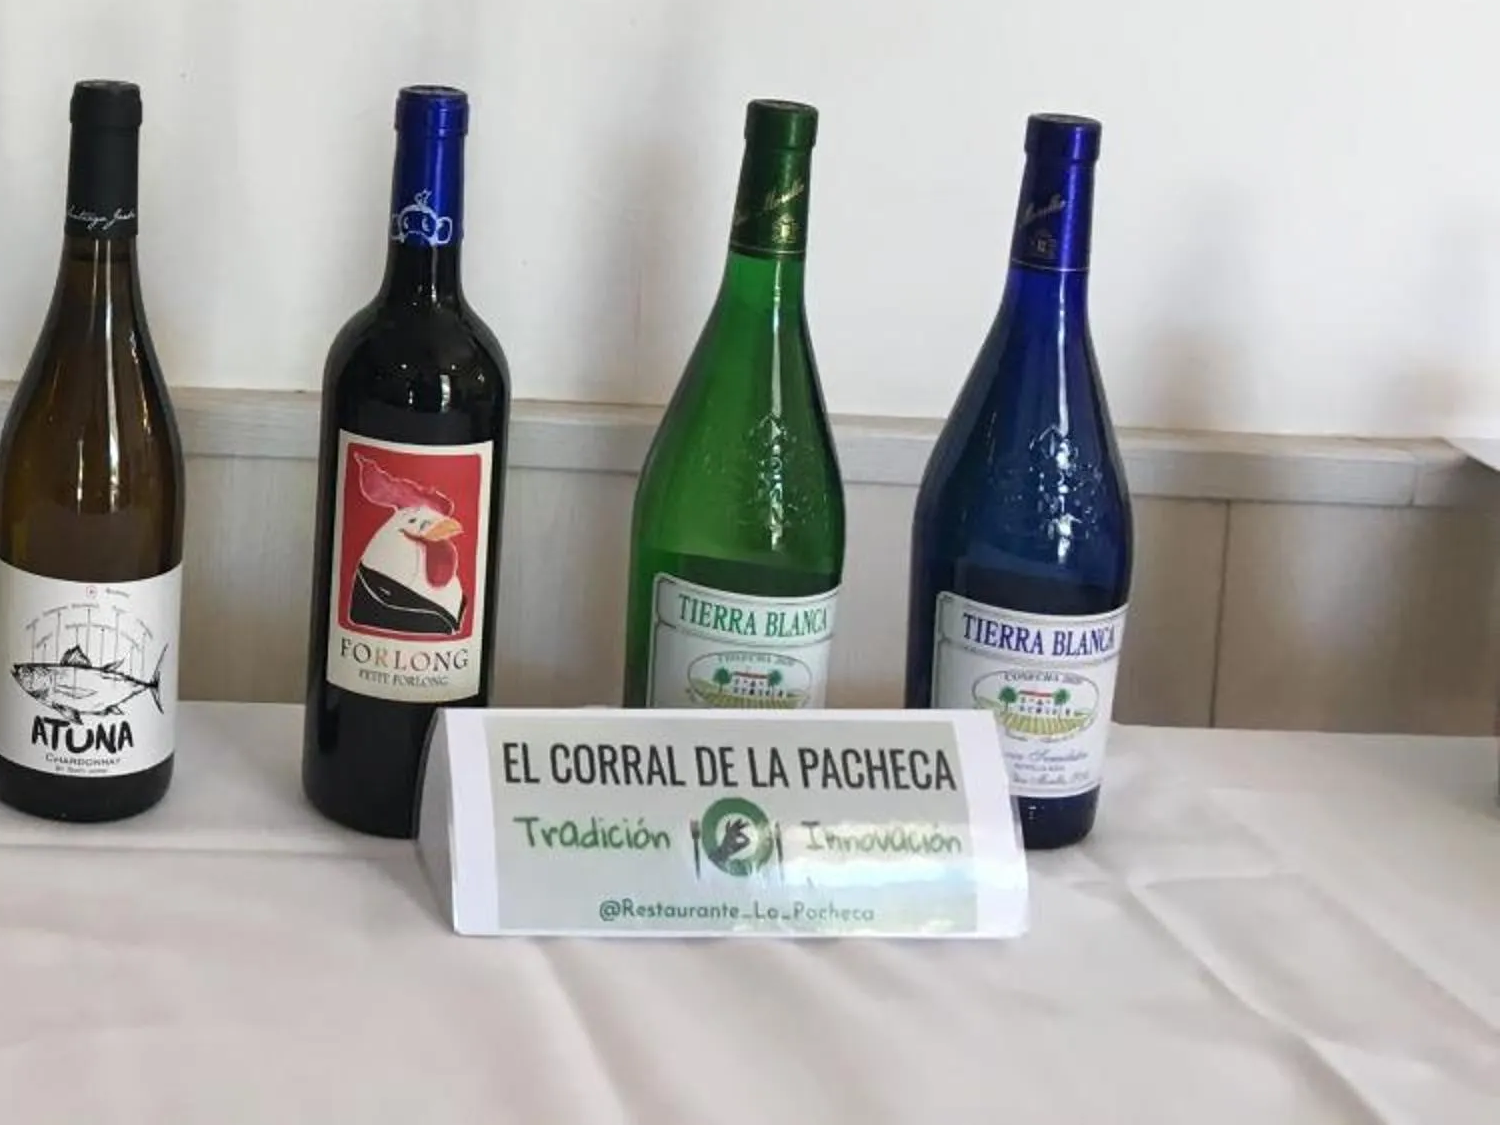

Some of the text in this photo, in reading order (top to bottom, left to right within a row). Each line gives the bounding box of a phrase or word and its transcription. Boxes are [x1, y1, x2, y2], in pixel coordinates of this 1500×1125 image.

[678, 593, 827, 638] TIERRA BLANCA
[963, 612, 1115, 657] TIERRA BLANCA
[340, 638, 469, 672] FORLONG
[31, 715, 134, 754] ATUNA
[503, 742, 958, 792] EL CORRAL DE LA PACHECA
[513, 816, 963, 854] Tradición Innovación
